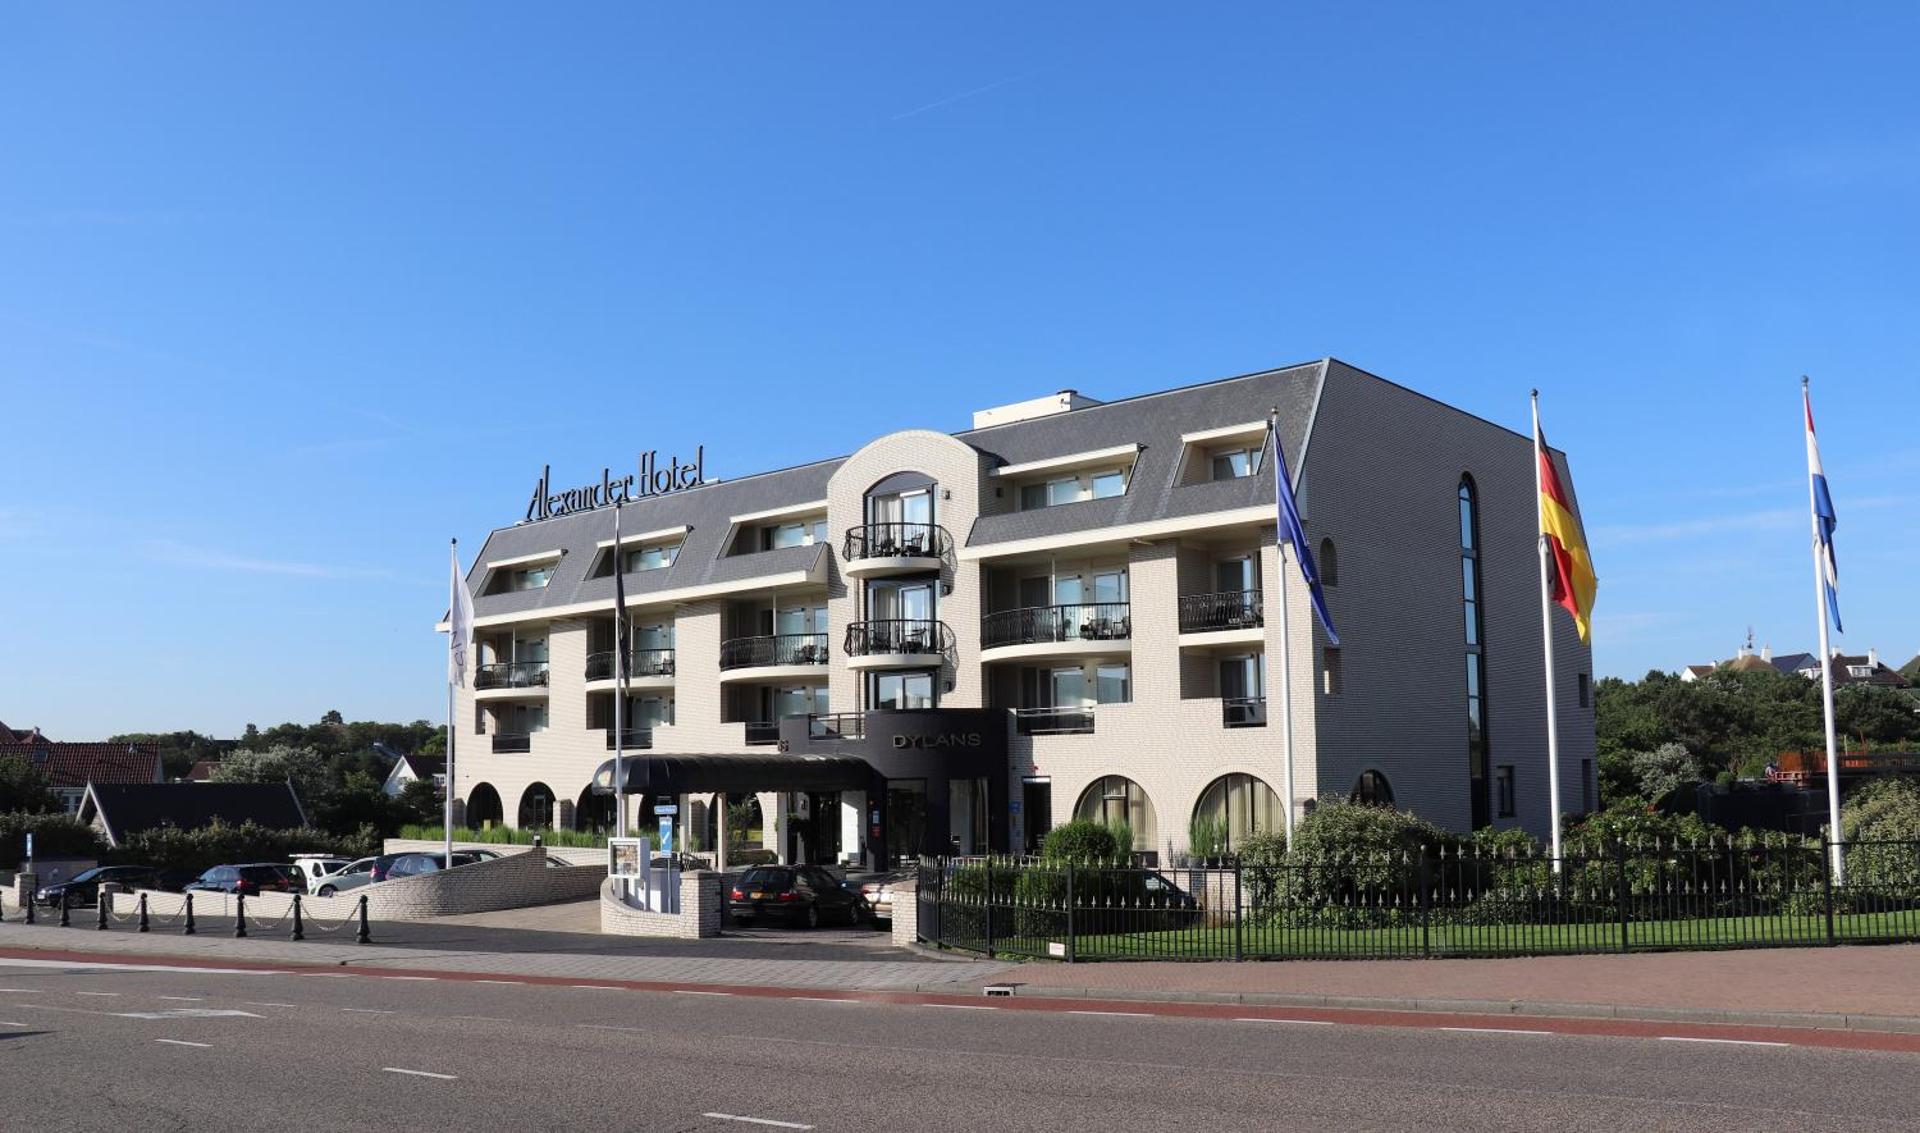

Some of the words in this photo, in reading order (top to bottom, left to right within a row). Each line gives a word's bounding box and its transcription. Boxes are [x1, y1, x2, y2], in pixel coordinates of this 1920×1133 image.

[526, 464, 633, 522] Alexander
[638, 445, 704, 497] Hotel
[892, 732, 982, 748] DYLANS
